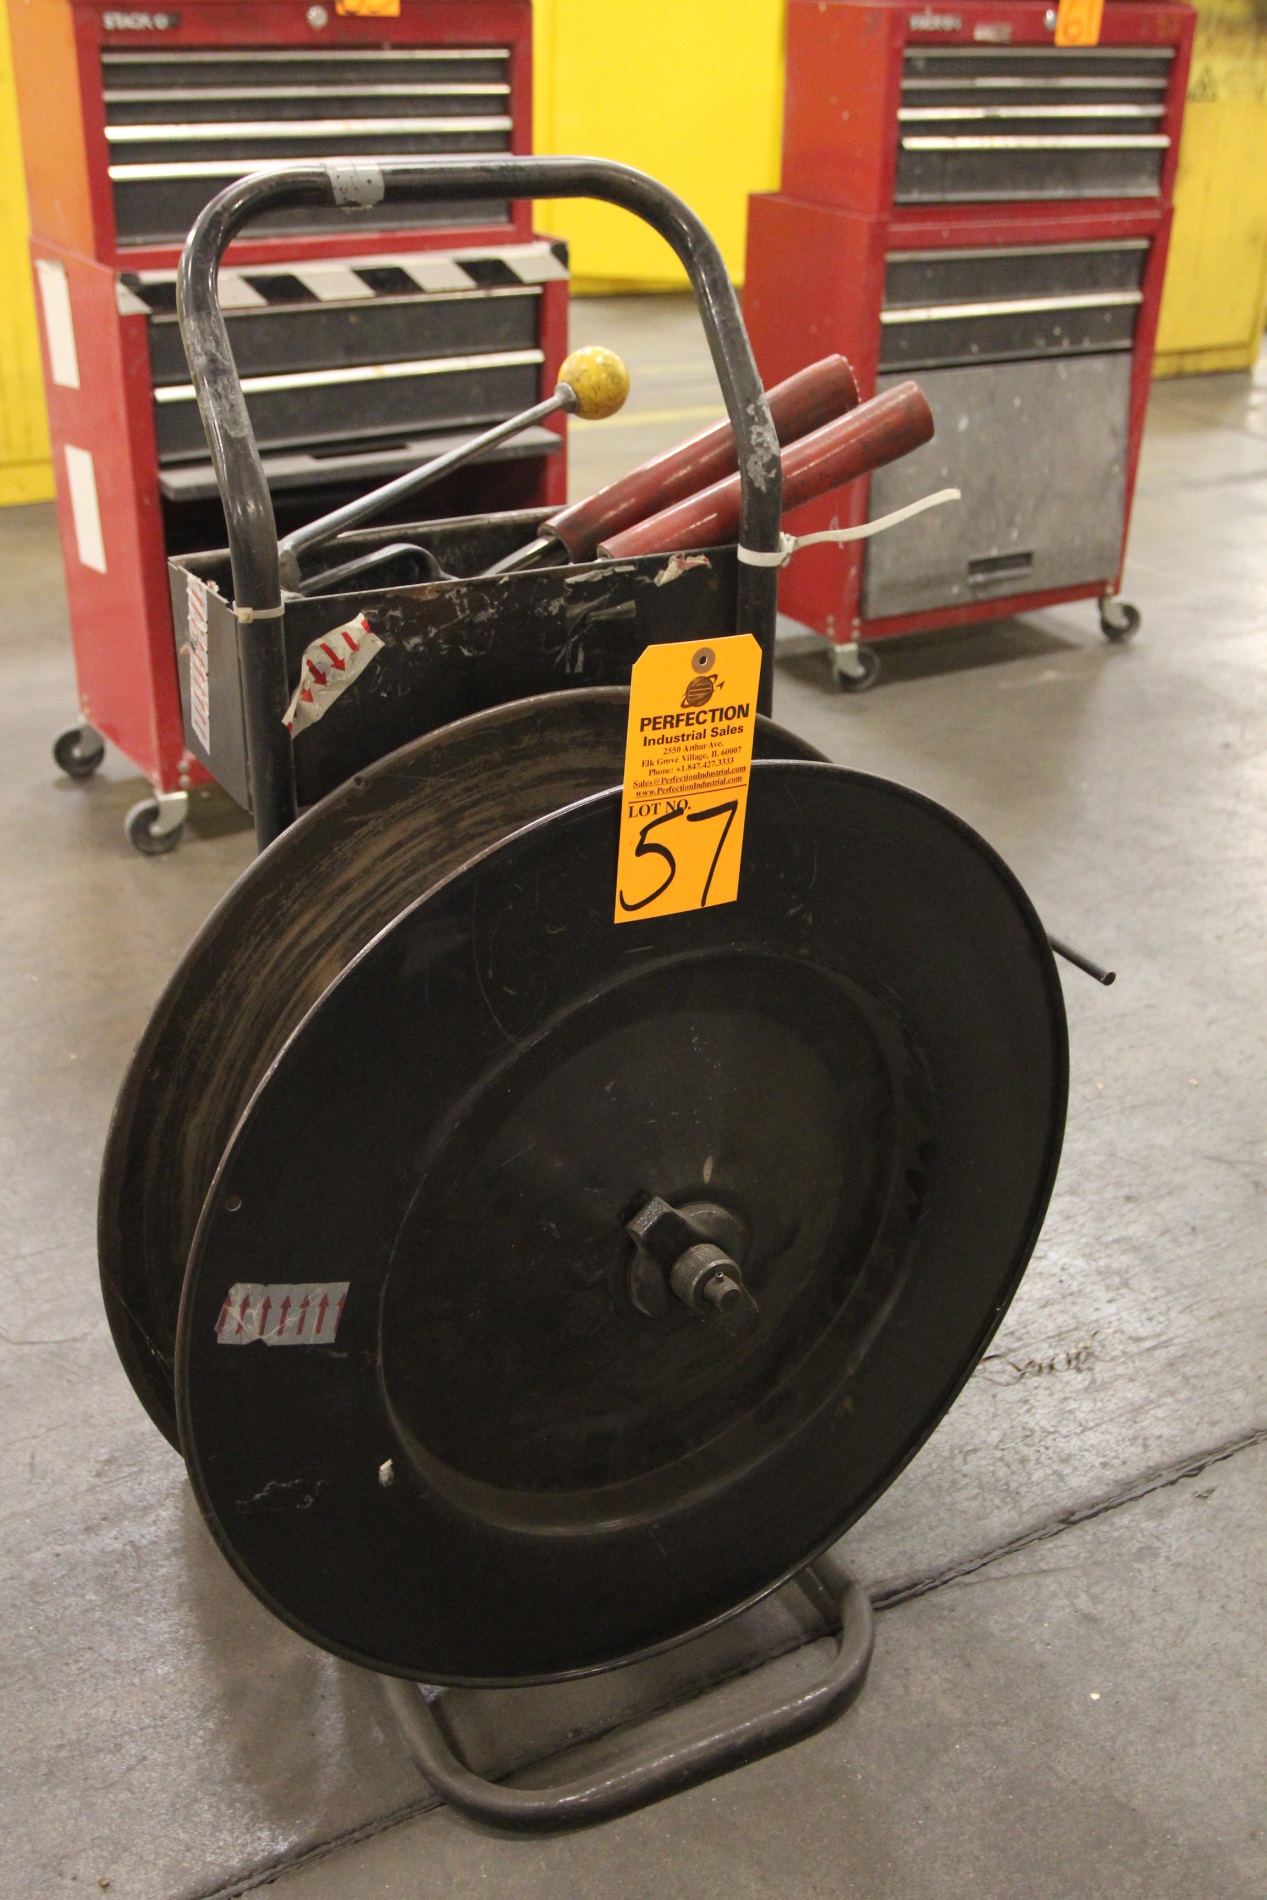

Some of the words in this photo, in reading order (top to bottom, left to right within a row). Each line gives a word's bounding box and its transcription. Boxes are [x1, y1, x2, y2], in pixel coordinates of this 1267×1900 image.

[640, 703, 750, 732] PERFECTION
[643, 729, 706, 746] Industrial
[710, 725, 744, 738] Sales
[641, 760, 655, 768] Elk
[656, 758, 679, 766] Grove
[681, 754, 709, 763] Village,
[711, 750, 719, 758] IL
[720, 746, 742, 756] 60007
[663, 746, 681, 755] 2550
[683, 742, 707, 752] Arthur
[708, 741, 724, 749] Ave.
[633, 766, 746, 788] Sales@PerfectionIndustrial.com
[648, 768, 674, 776] Phone:
[676, 757, 734, 772] +1.847.427.3333
[635, 776, 743, 797] www.PerfectionIndustrial.com
[628, 802, 662, 818] LOT
[665, 799, 691, 815] NO.
[619, 799, 738, 911] 57
